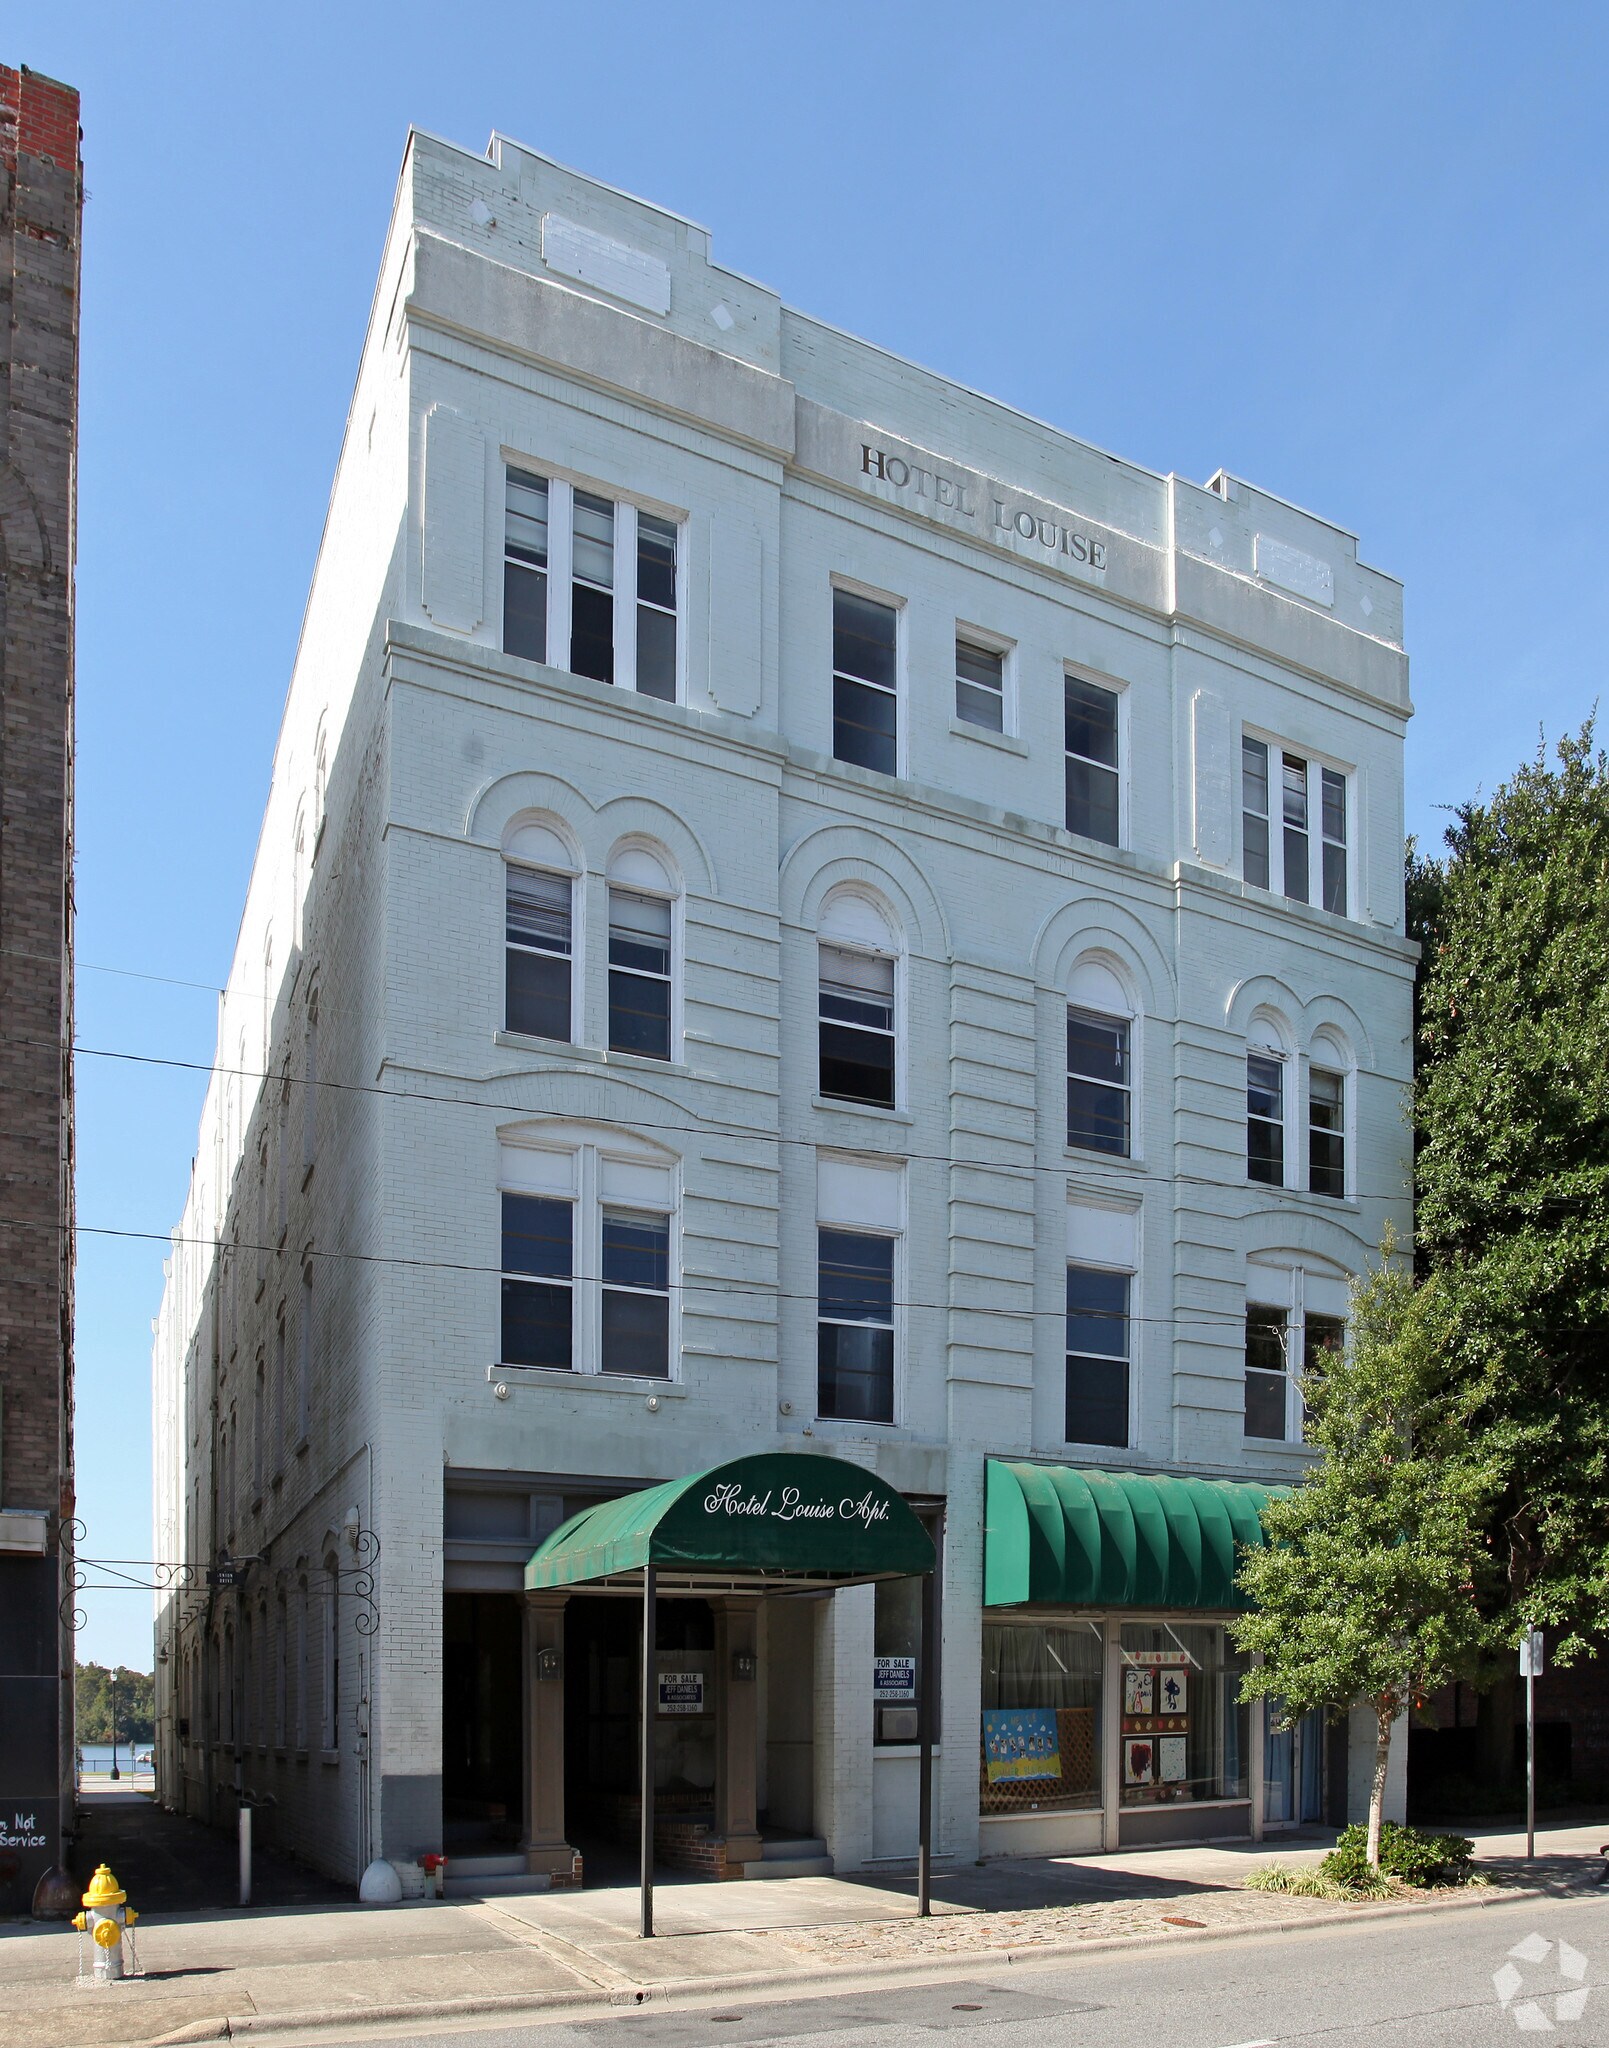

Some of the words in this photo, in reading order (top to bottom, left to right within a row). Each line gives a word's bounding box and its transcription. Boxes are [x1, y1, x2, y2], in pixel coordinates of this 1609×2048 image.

[860, 443, 975, 518] HOTEL
[993, 499, 1107, 570] LOUISE
[704, 1484, 772, 1517] Hotel
[771, 1486, 835, 1521] Louise
[839, 1490, 890, 1529] Apt.
[877, 1659, 890, 1668] FOR
[893, 1659, 910, 1668] SALE
[664, 1674, 677, 1683] FOR
[680, 1674, 697, 1683] SALE
[877, 1670, 889, 1679] JEFF
[889, 1670, 910, 1679] DANIELS
[665, 1685, 677, 1693] JEFF
[676, 1685, 697, 1693] DANIELS
[15, 1813, 36, 1831] Not
[0, 1831, 46, 1847] Service
